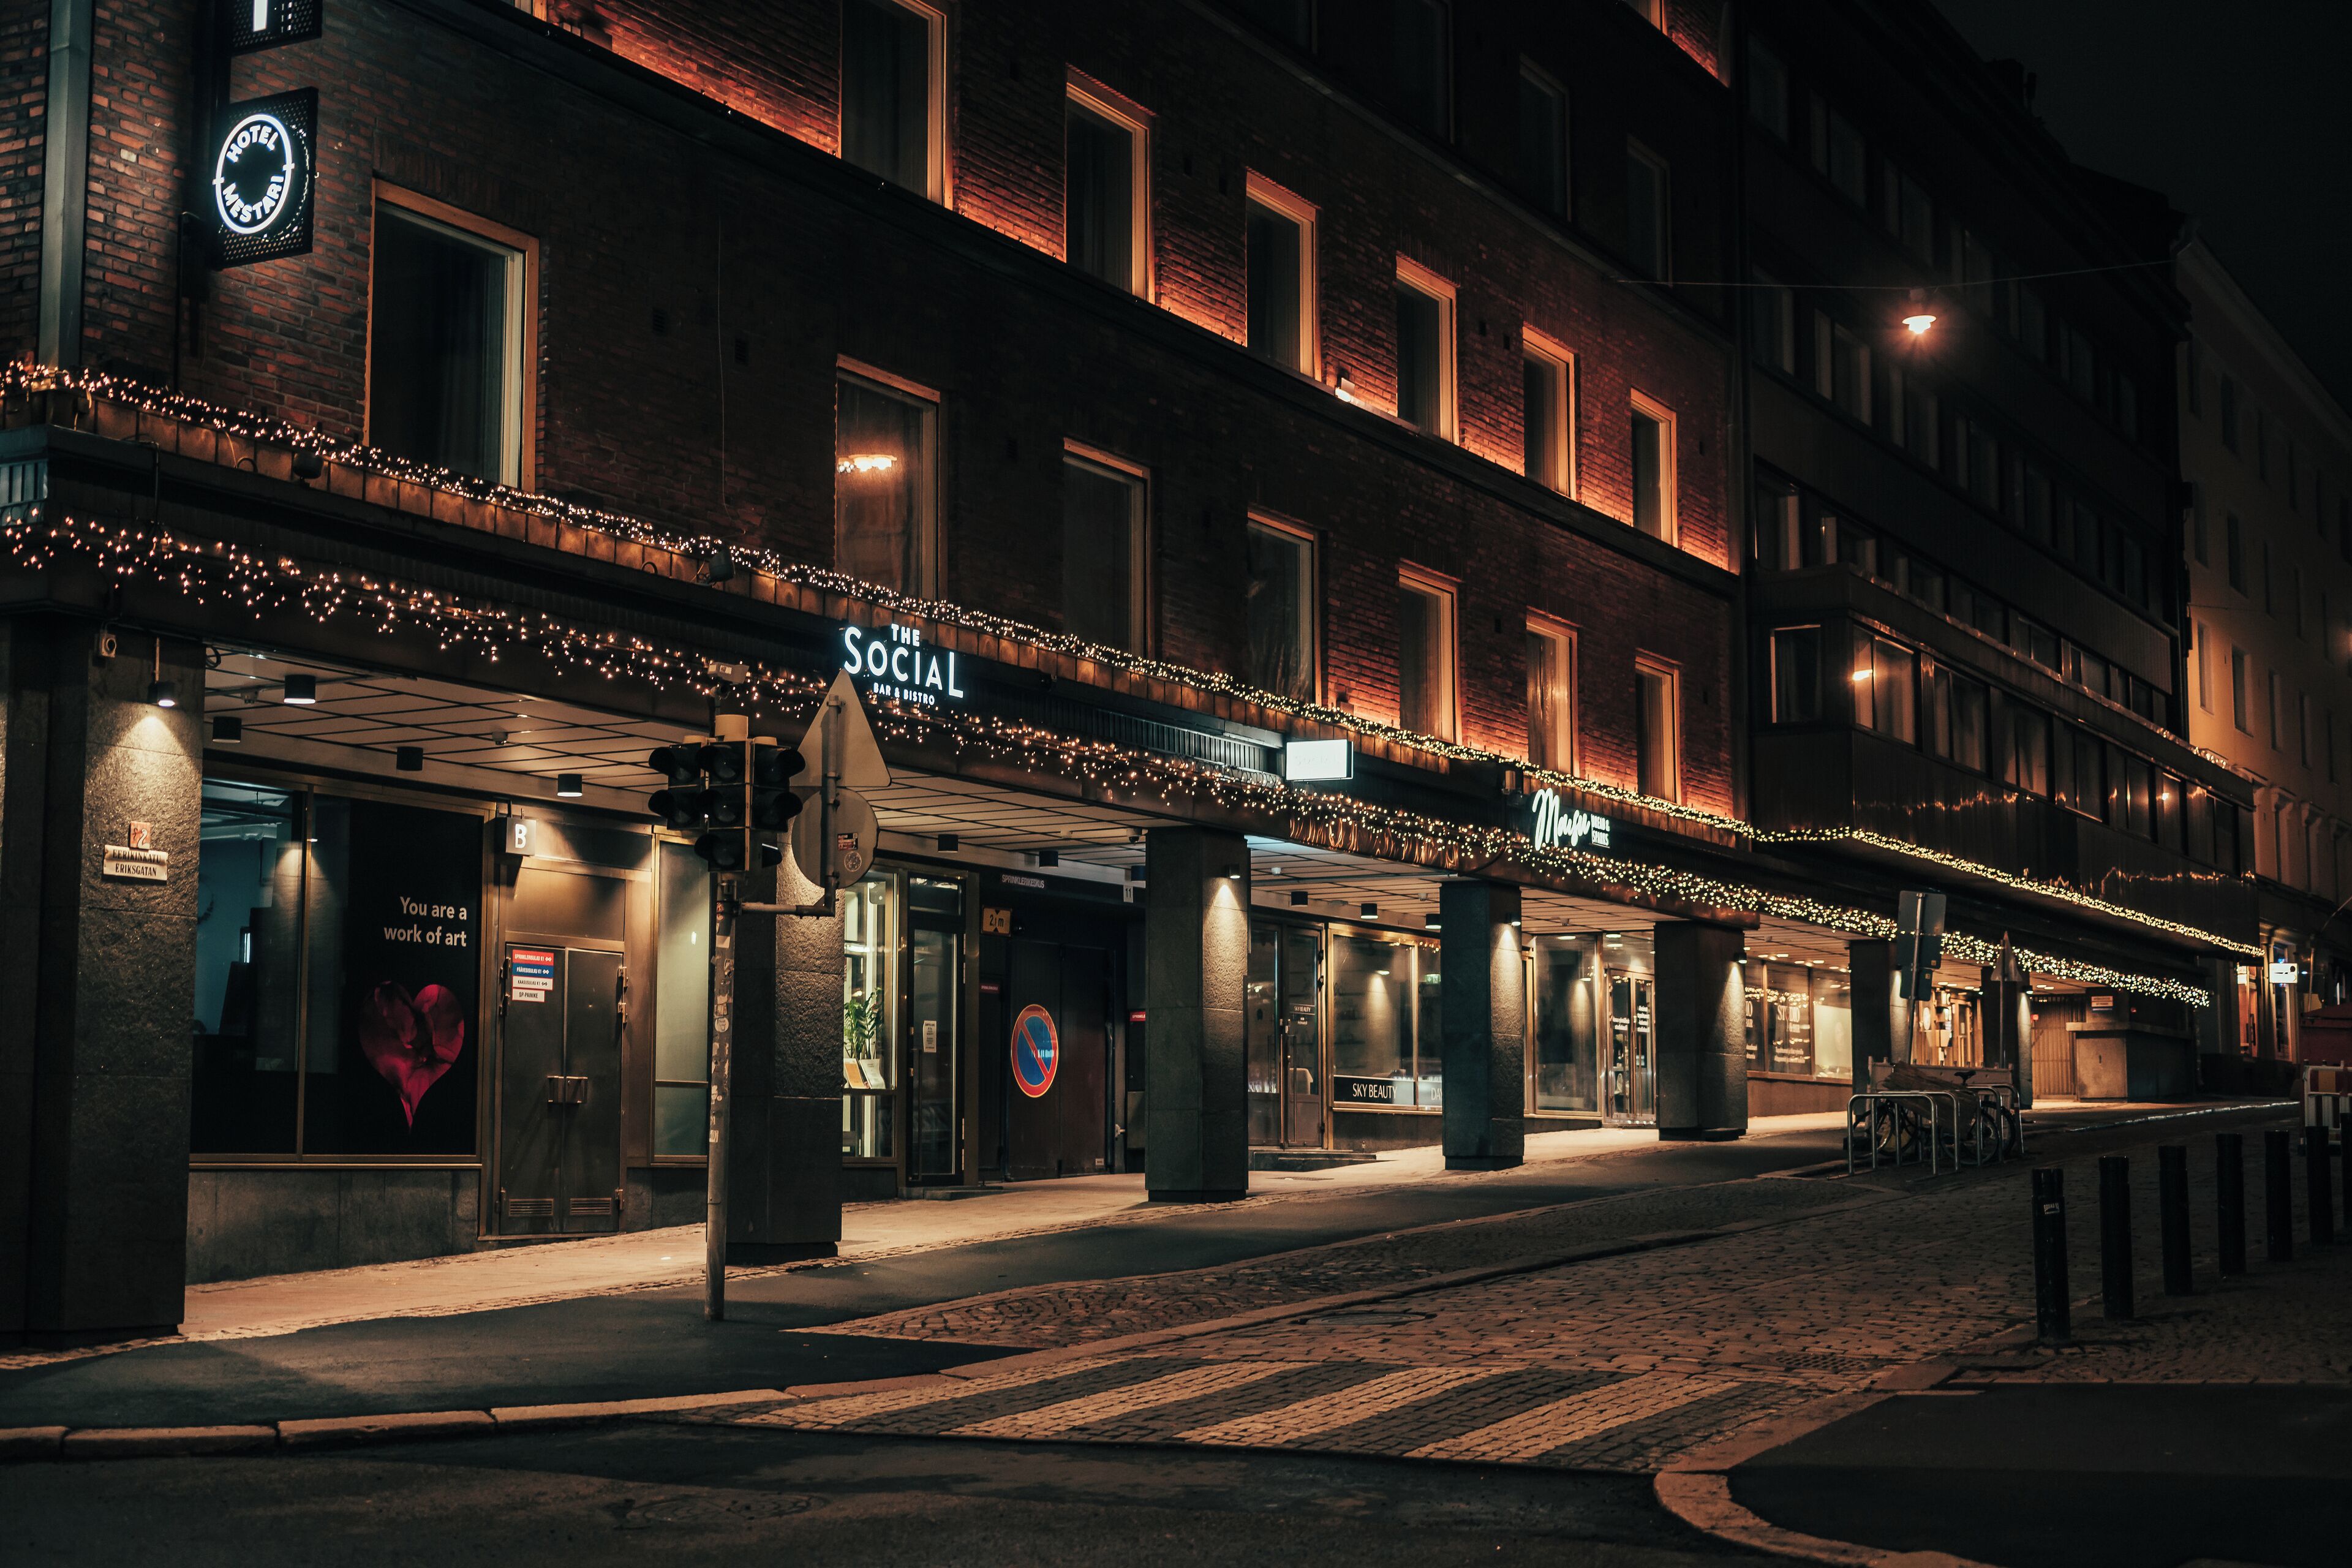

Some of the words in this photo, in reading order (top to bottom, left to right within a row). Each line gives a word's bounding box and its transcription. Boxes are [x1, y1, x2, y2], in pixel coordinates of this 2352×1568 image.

[226, 124, 279, 163] HOTEL
[222, 175, 284, 223] MESTARI
[891, 623, 920, 647] THE
[844, 626, 963, 698] SOCIAL
[873, 682, 891, 696] BAR
[894, 687, 900, 698] &
[903, 688, 935, 705] BISTRO
[515, 824, 526, 848] B
[115, 862, 157, 876] ERIKSGATAN
[1126, 887, 1131, 898] 11
[400, 896, 427, 916] You
[431, 905, 454, 919] are
[459, 907, 467, 921] a
[998, 918, 1004, 927] m
[384, 924, 421, 943] work
[426, 926, 442, 944] of
[445, 931, 467, 947] art
[1352, 1083, 1368, 1098] SKY
[1368, 1084, 1397, 1099] BEAUTY
